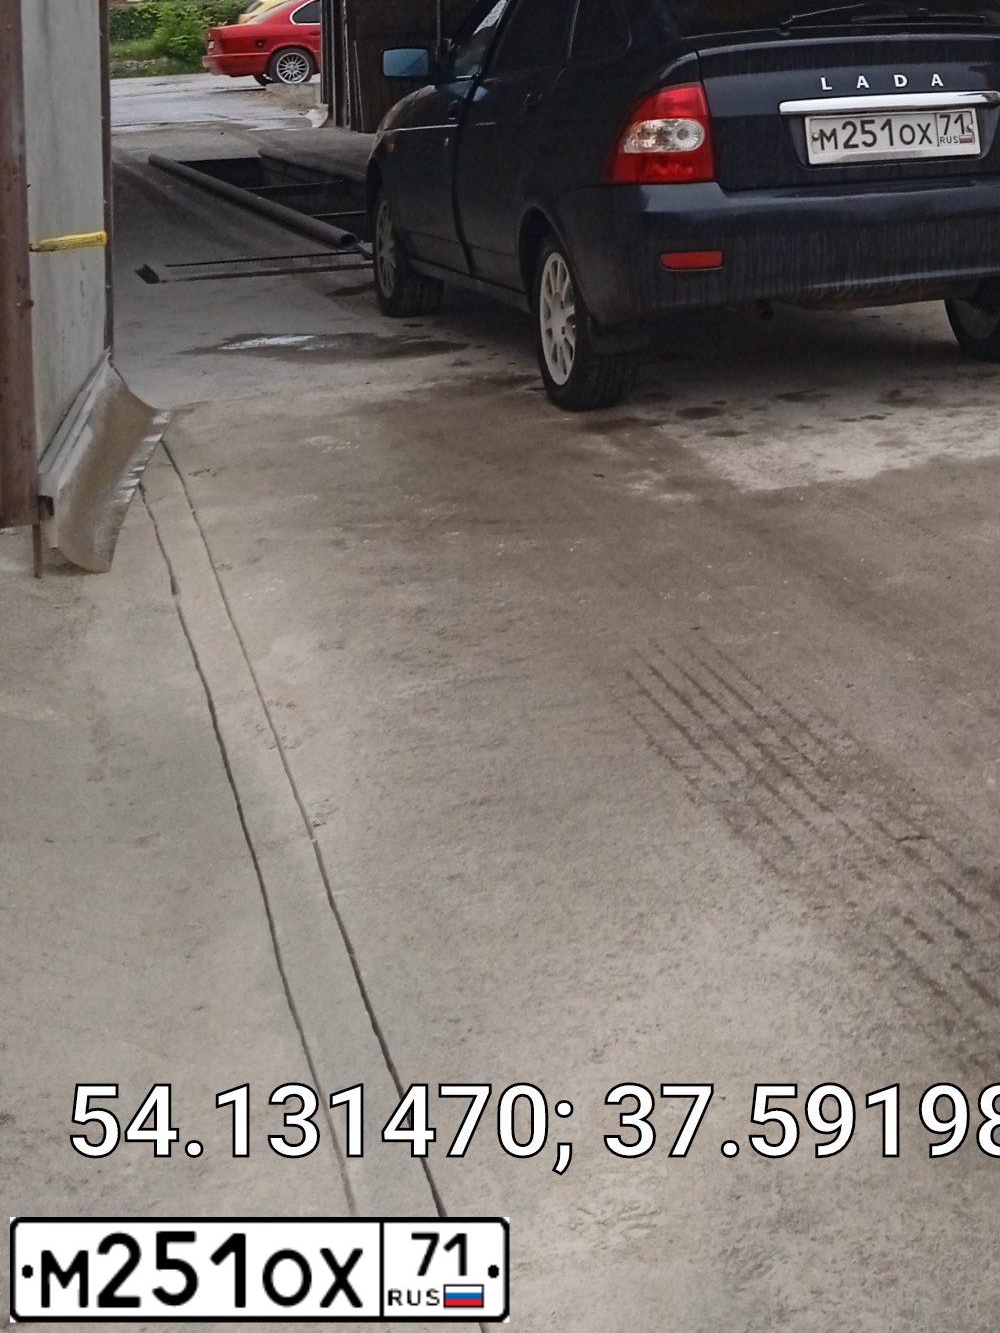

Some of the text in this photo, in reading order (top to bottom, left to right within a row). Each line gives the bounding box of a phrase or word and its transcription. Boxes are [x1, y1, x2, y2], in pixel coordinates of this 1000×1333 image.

[820, 73, 944, 91] LADA
[939, 113, 966, 136] 71
[939, 135, 959, 145] RUS
